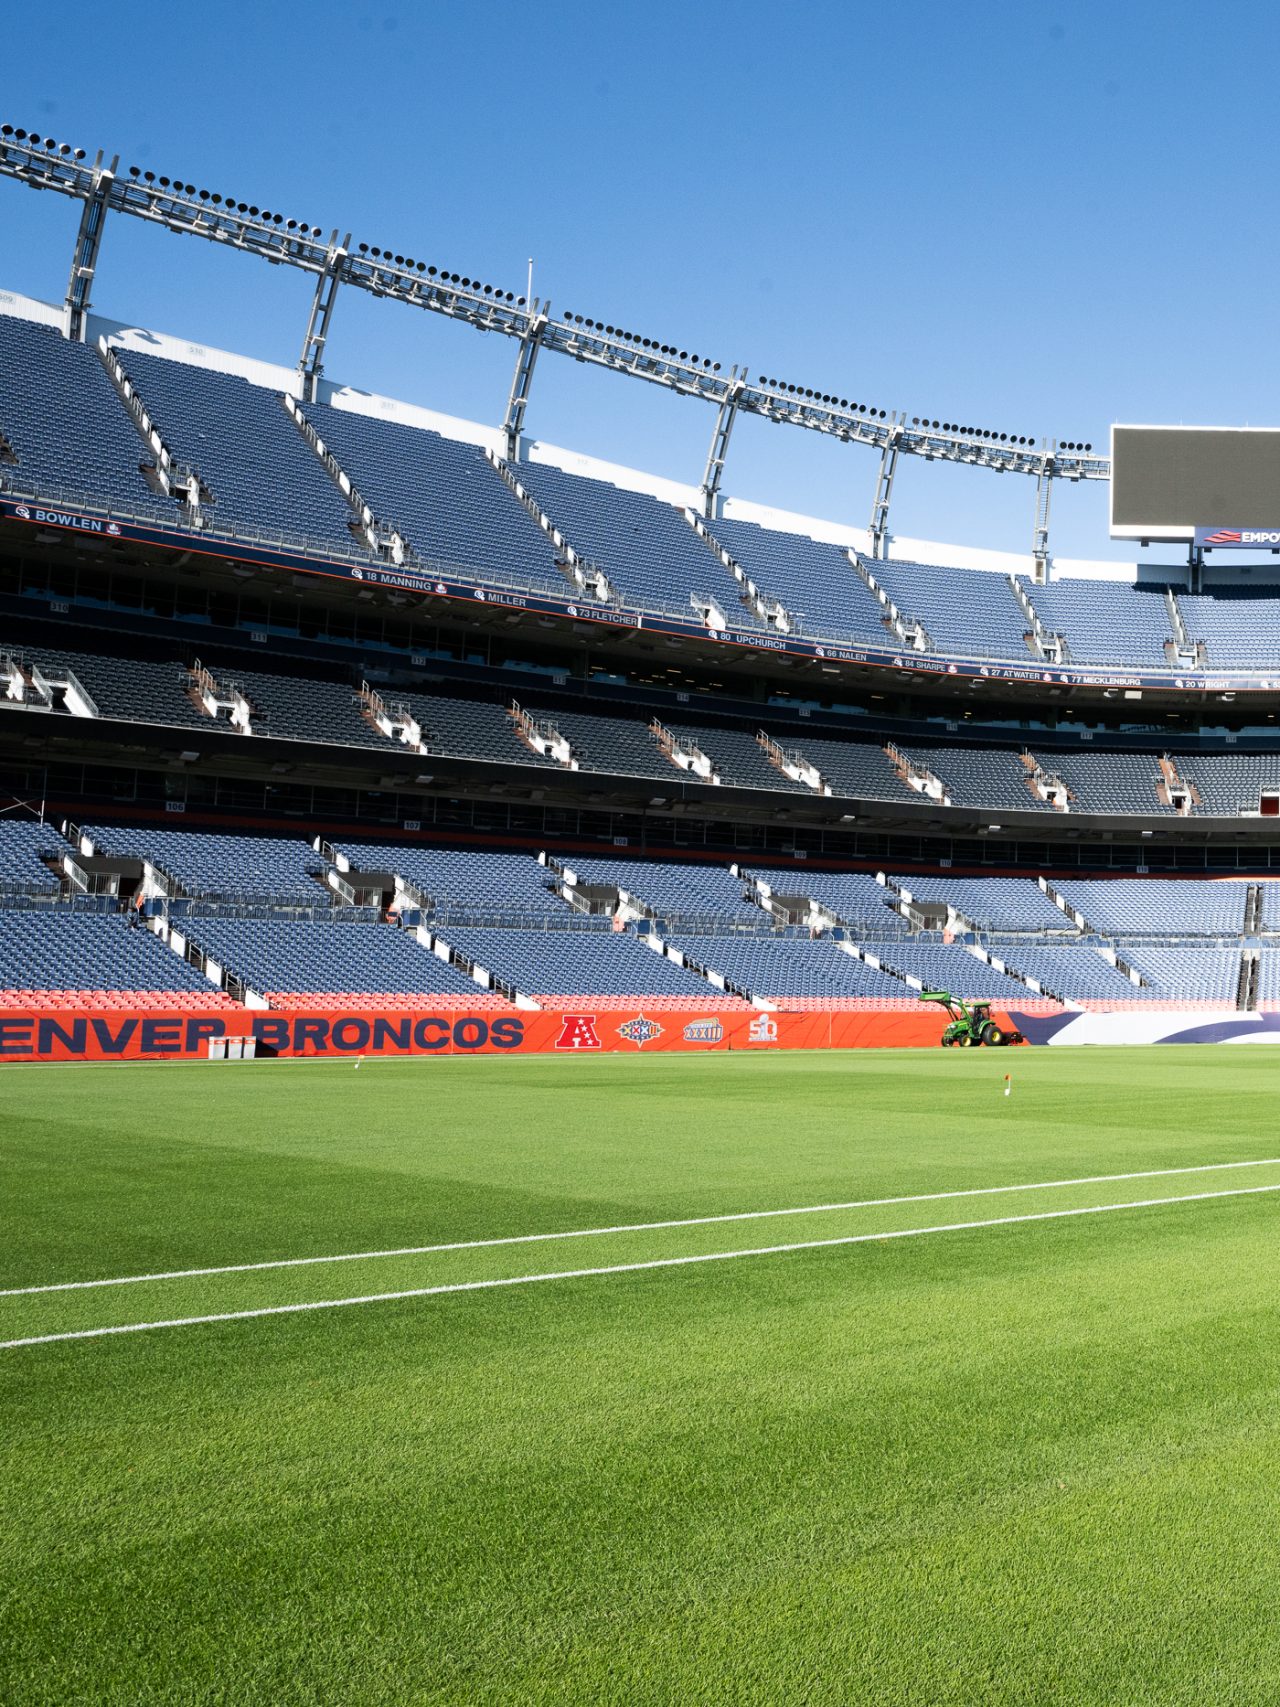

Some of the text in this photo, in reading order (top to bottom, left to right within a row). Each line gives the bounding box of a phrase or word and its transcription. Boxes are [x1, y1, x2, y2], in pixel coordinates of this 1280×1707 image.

[36, 510, 102, 532] BOWLEN
[366, 571, 432, 591] 18 MANNING
[488, 593, 526, 607] MILLER
[579, 608, 637, 627] 73 FLETCHER
[720, 632, 787, 651] 80 UPCHURCH
[827, 649, 867, 662] 66 NALEN
[905, 659, 947, 672] 84 SHARPE
[991, 669, 1040, 681] 27 ATWATER
[1071, 675, 1141, 687] 77 MECKLENBURG
[1185, 679, 1230, 689] 20 WRIGHT
[168, 803, 184, 811] 106
[406, 822, 419, 830] 107
[0, 1017, 525, 1054] ENVER BRONCOS
